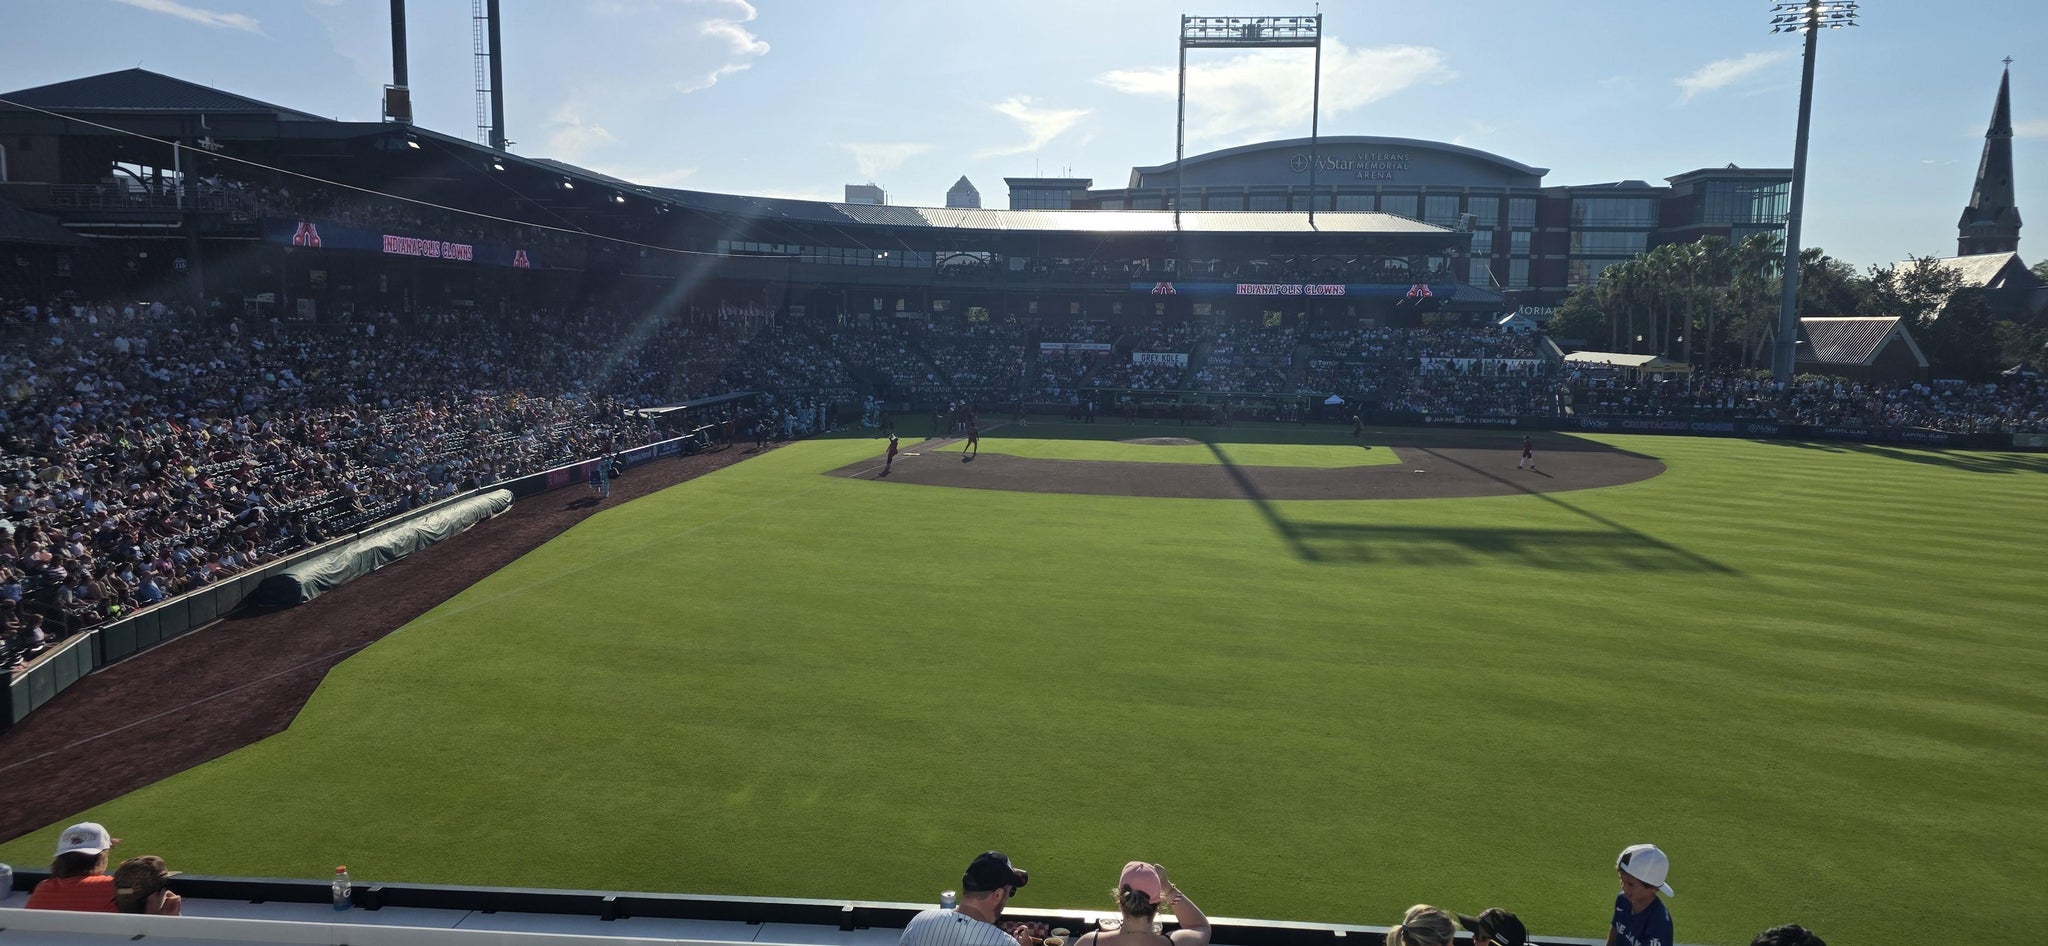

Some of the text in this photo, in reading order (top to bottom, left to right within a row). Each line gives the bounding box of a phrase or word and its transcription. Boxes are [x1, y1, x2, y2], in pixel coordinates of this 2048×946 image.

[1357, 153, 1409, 161] VETERANS
[1356, 162, 1409, 170] MEMORIAL
[383, 234, 473, 261] INDIANAPOLIS CLOWNS
[1236, 284, 1346, 296] INDIANAPOLIS CLOWNS
[1142, 353, 1159, 362] GREY
